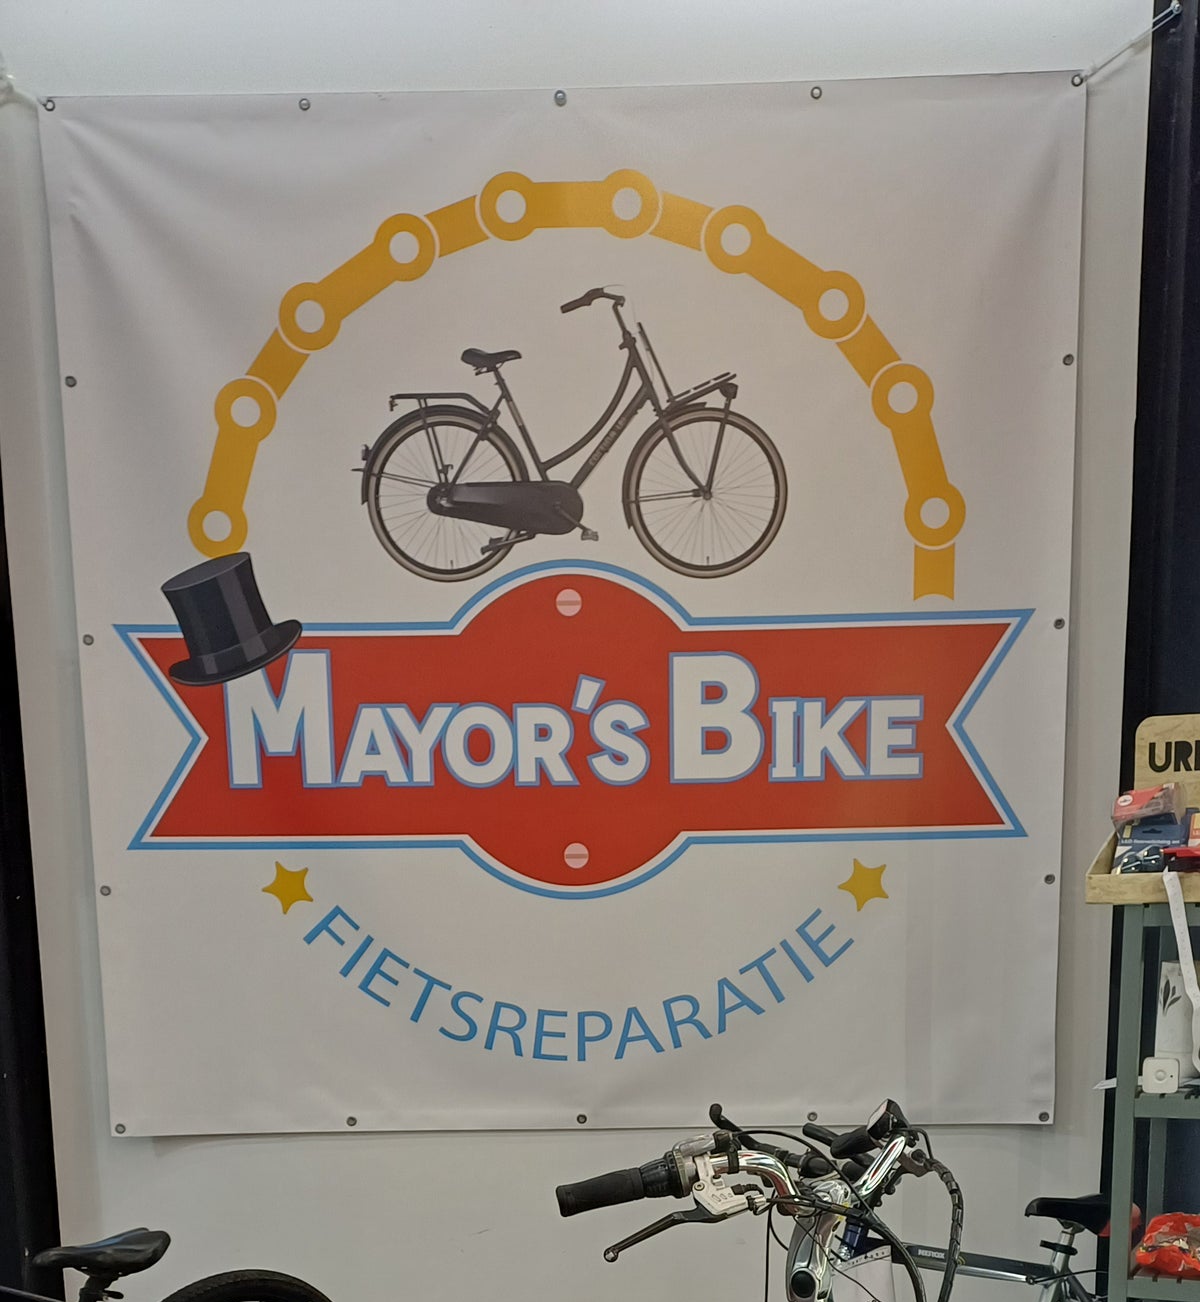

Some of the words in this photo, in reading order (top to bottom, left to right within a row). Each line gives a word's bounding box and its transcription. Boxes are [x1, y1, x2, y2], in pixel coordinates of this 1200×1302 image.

[223, 649, 650, 789] MAYOR'S
[669, 650, 924, 784] BIKE
[303, 905, 854, 1062] FIETSREPARATIE
